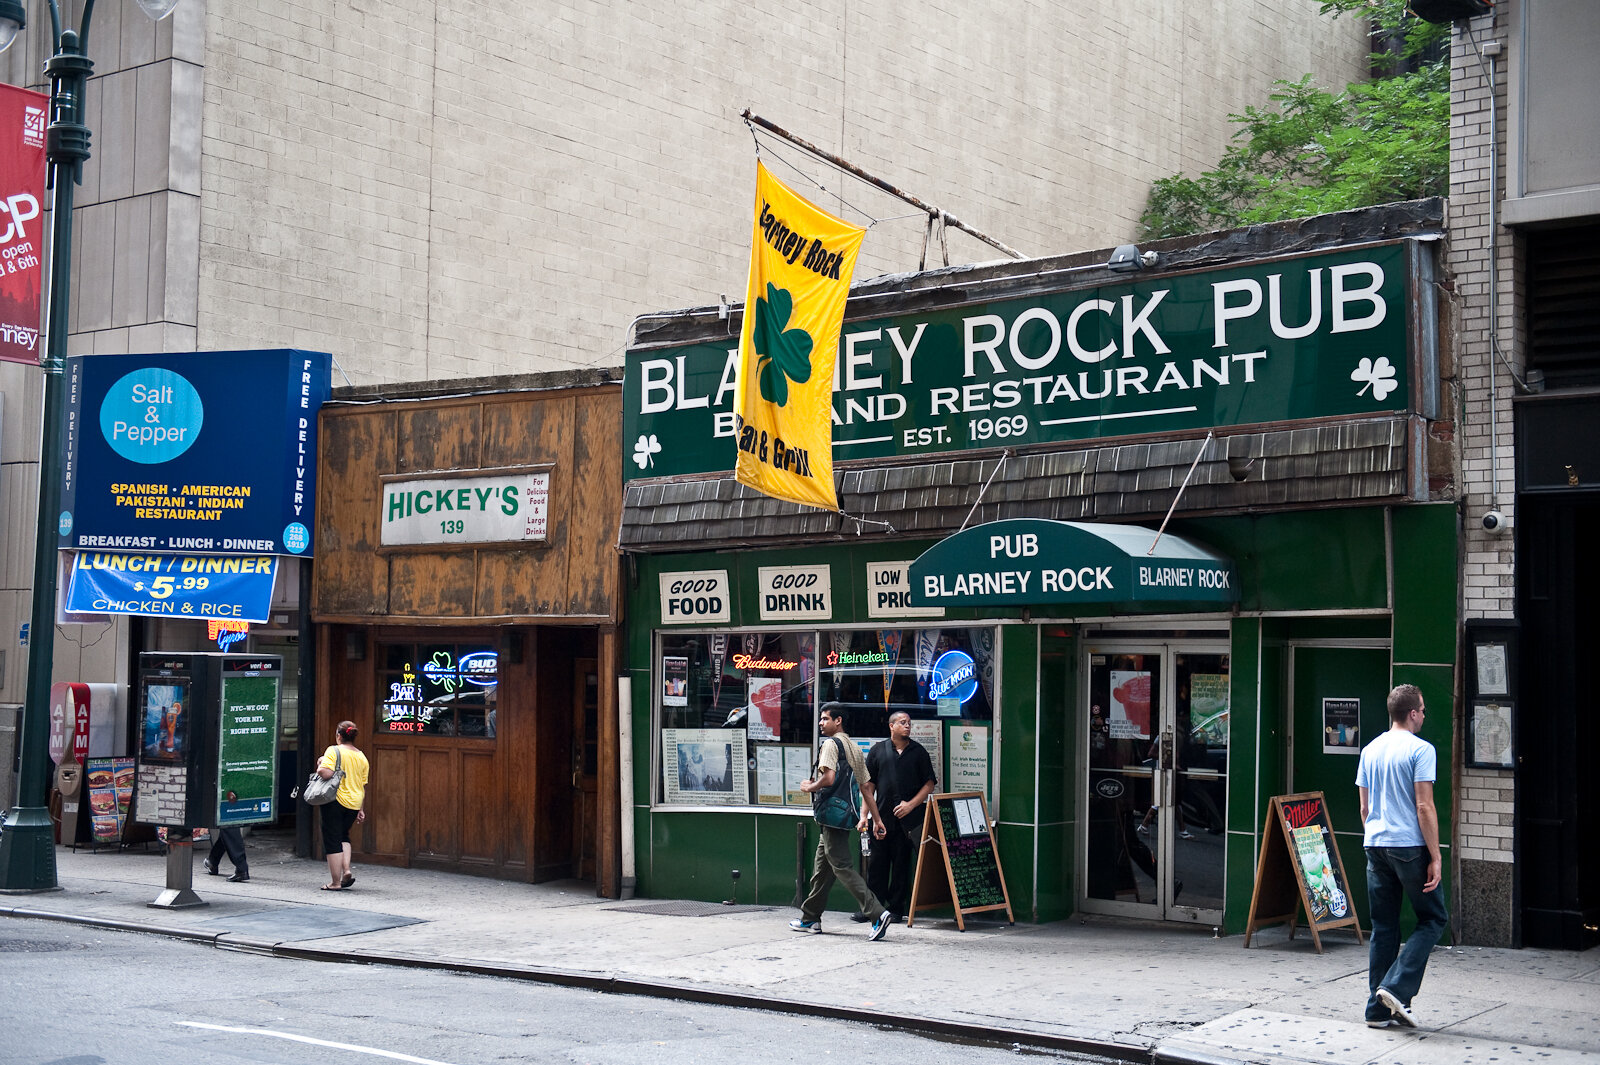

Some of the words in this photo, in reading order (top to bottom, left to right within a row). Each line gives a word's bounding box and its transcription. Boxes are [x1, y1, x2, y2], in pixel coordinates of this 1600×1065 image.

[0, 193, 40, 244] CP
[2, 241, 33, 259] open
[802, 238, 844, 280] Rock
[17, 254, 39, 270] 6th
[640, 322, 929, 415] BLAEY
[962, 289, 1171, 378] ROCK
[1211, 261, 1387, 348] PUB
[301, 359, 312, 409] FREE
[930, 350, 1267, 416] RESTAURANT
[132, 384, 173, 404] Salt
[144, 406, 161, 424] &
[113, 421, 187, 446] Pepper
[903, 425, 951, 448] EST.
[968, 414, 1028, 441] 1969
[65, 411, 75, 491] DELIVERY
[759, 430, 768, 463] &
[773, 437, 813, 478] Grill
[294, 418, 308, 517] DELIVERY
[110, 483, 168, 495] SPANISH
[181, 485, 251, 497] AMERICAN
[533, 478, 544, 486] For
[116, 496, 185, 507] PAKISTANI
[198, 498, 244, 509] INDIAN
[388, 485, 519, 523] HICKEY'S
[529, 497, 545, 505] Food
[59, 518, 73, 528] 139
[135, 508, 222, 520] RESTAURANT
[527, 516, 545, 526] Large
[290, 526, 304, 534] 212
[440, 520, 464, 534] 139
[525, 527, 546, 535] Drinks
[79, 535, 156, 548] BREAKFAST
[168, 537, 214, 549] LUNCH
[223, 538, 274, 551] DINNER
[990, 533, 1039, 559] PUB
[78, 553, 163, 572] LUNCH
[182, 556, 272, 575] DINNER
[670, 578, 718, 595] GOOD
[772, 573, 818, 590] GOOD
[875, 569, 901, 586] LOW
[924, 570, 1032, 597] BLARNEY
[1041, 566, 1114, 592] ROCK
[1139, 566, 1193, 588] BLARNEY
[1198, 569, 1230, 589] ROCK
[92, 599, 175, 614] CHICKEN
[181, 602, 194, 613] &
[200, 602, 242, 617] RICE
[669, 597, 722, 615] FOOD
[766, 593, 826, 612] DRINK
[877, 591, 911, 608] PRIC
[250, 661, 272, 670] verizon
[467, 659, 497, 669] BUD
[732, 653, 798, 670] Budweiser
[839, 650, 890, 664] Heineken
[929, 678, 950, 700] BLUE
[950, 665, 973, 686] MOON
[51, 703, 64, 748] ATM
[75, 703, 88, 748] ATM
[230, 727, 250, 735] RIGHT
[1283, 799, 1320, 828] Miller
